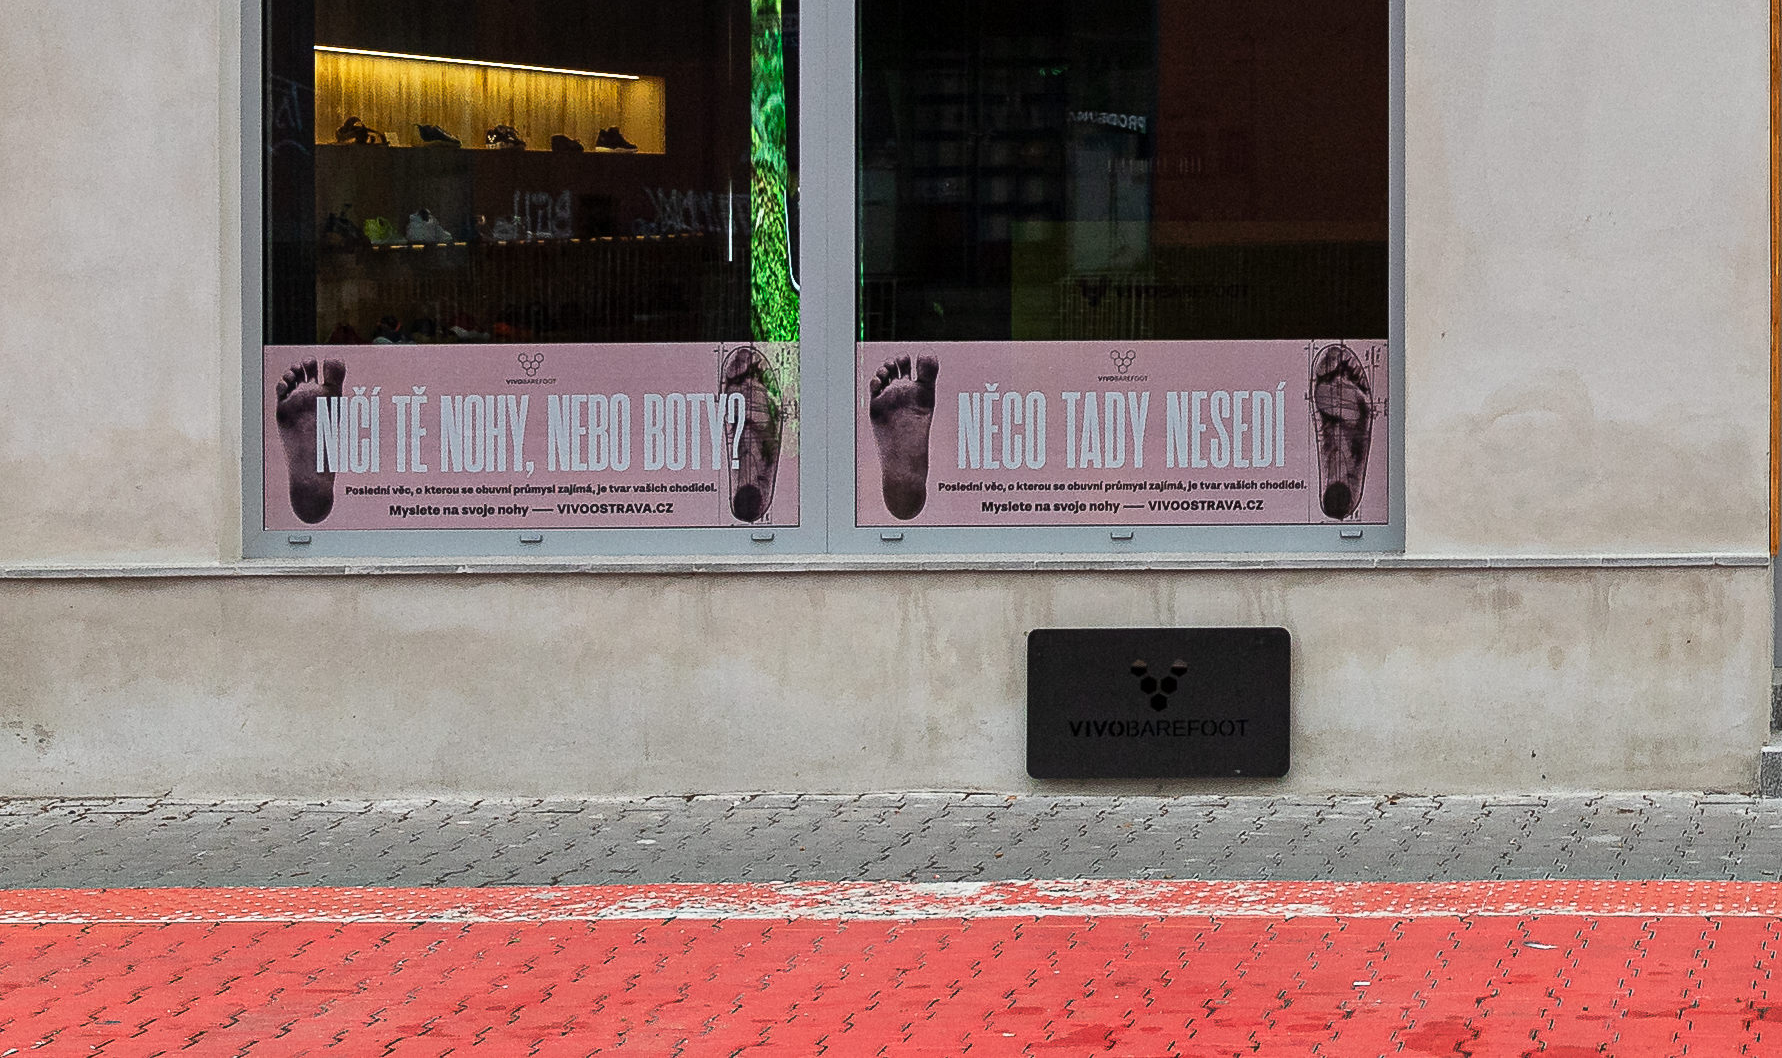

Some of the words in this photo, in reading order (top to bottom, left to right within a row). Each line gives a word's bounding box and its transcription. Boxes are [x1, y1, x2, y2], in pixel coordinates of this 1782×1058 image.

[316, 387, 381, 472] NIČÍ
[392, 386, 428, 472] TĚ
[440, 395, 534, 478] NOHY,
[547, 393, 630, 471] NEBO
[643, 392, 745, 471] BOTY?
[957, 382, 1047, 470] NĚCO
[1062, 391, 1150, 469] TADY
[1166, 381, 1286, 468] NESEDÍ
[345, 485, 390, 495] Poslední
[424, 485, 456, 494] kterou
[475, 484, 512, 494] obuvní
[513, 484, 555, 496] průmysl
[558, 483, 595, 495] zajímá,
[609, 484, 631, 493] tvar
[633, 483, 667, 493] vašich
[669, 483, 717, 493] chodidel.
[938, 482, 982, 492] Poslední
[1017, 481, 1050, 491] kterou
[1068, 481, 1103, 490] obuvní
[1105, 480, 1147, 492] průmysl
[1149, 481, 1187, 492] zajímá,
[1200, 482, 1222, 490] tvar
[1225, 480, 1258, 490] vašich
[1261, 480, 1307, 490] chodidel.
[389, 505, 440, 518] Myslete
[443, 507, 459, 515] na
[462, 504, 495, 517] svoje
[497, 504, 529, 517] nohy
[557, 503, 674, 514] VIVOOSTRAVA.CZ
[982, 501, 1033, 514] Myslete
[1035, 503, 1050, 511] na
[1053, 500, 1087, 513] svoje
[1089, 500, 1120, 514] nohy
[1148, 499, 1264, 511] VIVOOSTRAVA.CZ
[1069, 719, 1249, 737] VIVOBAREFOOT
